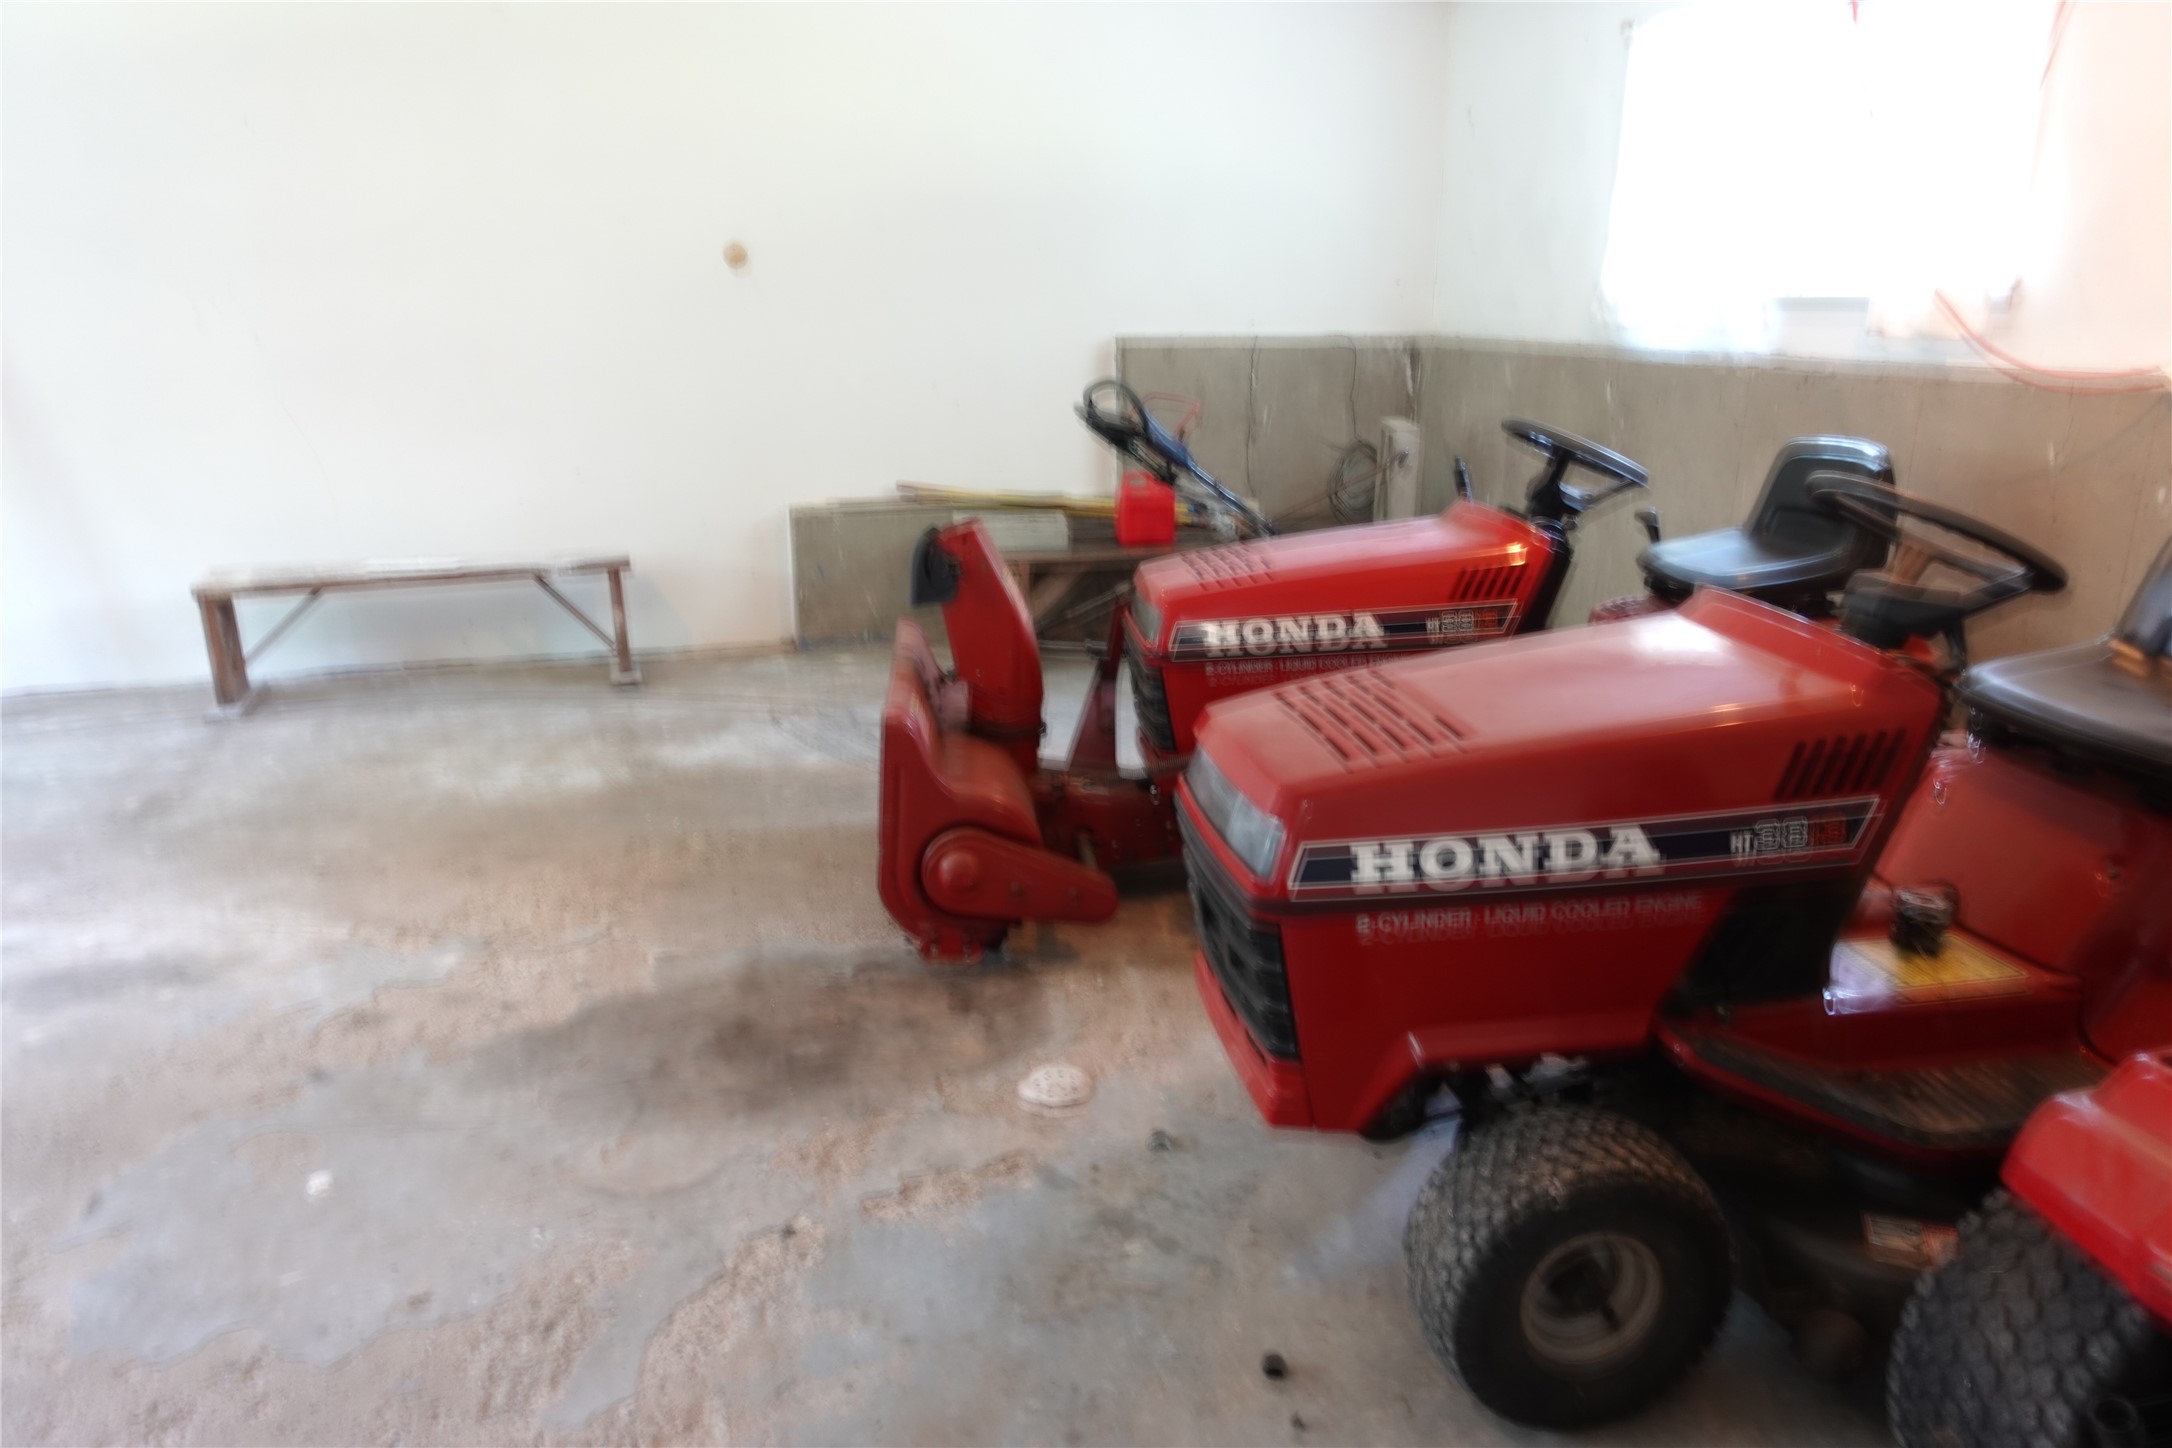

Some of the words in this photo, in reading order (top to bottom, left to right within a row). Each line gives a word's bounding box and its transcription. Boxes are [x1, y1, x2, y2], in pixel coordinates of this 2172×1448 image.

[1200, 612, 1388, 657] HONDA
[1350, 824, 1663, 893] HONDA
[1484, 902, 1548, 932] LIQUID
[1552, 897, 1632, 928] COOLED
[1635, 892, 1704, 922] ENGINE
